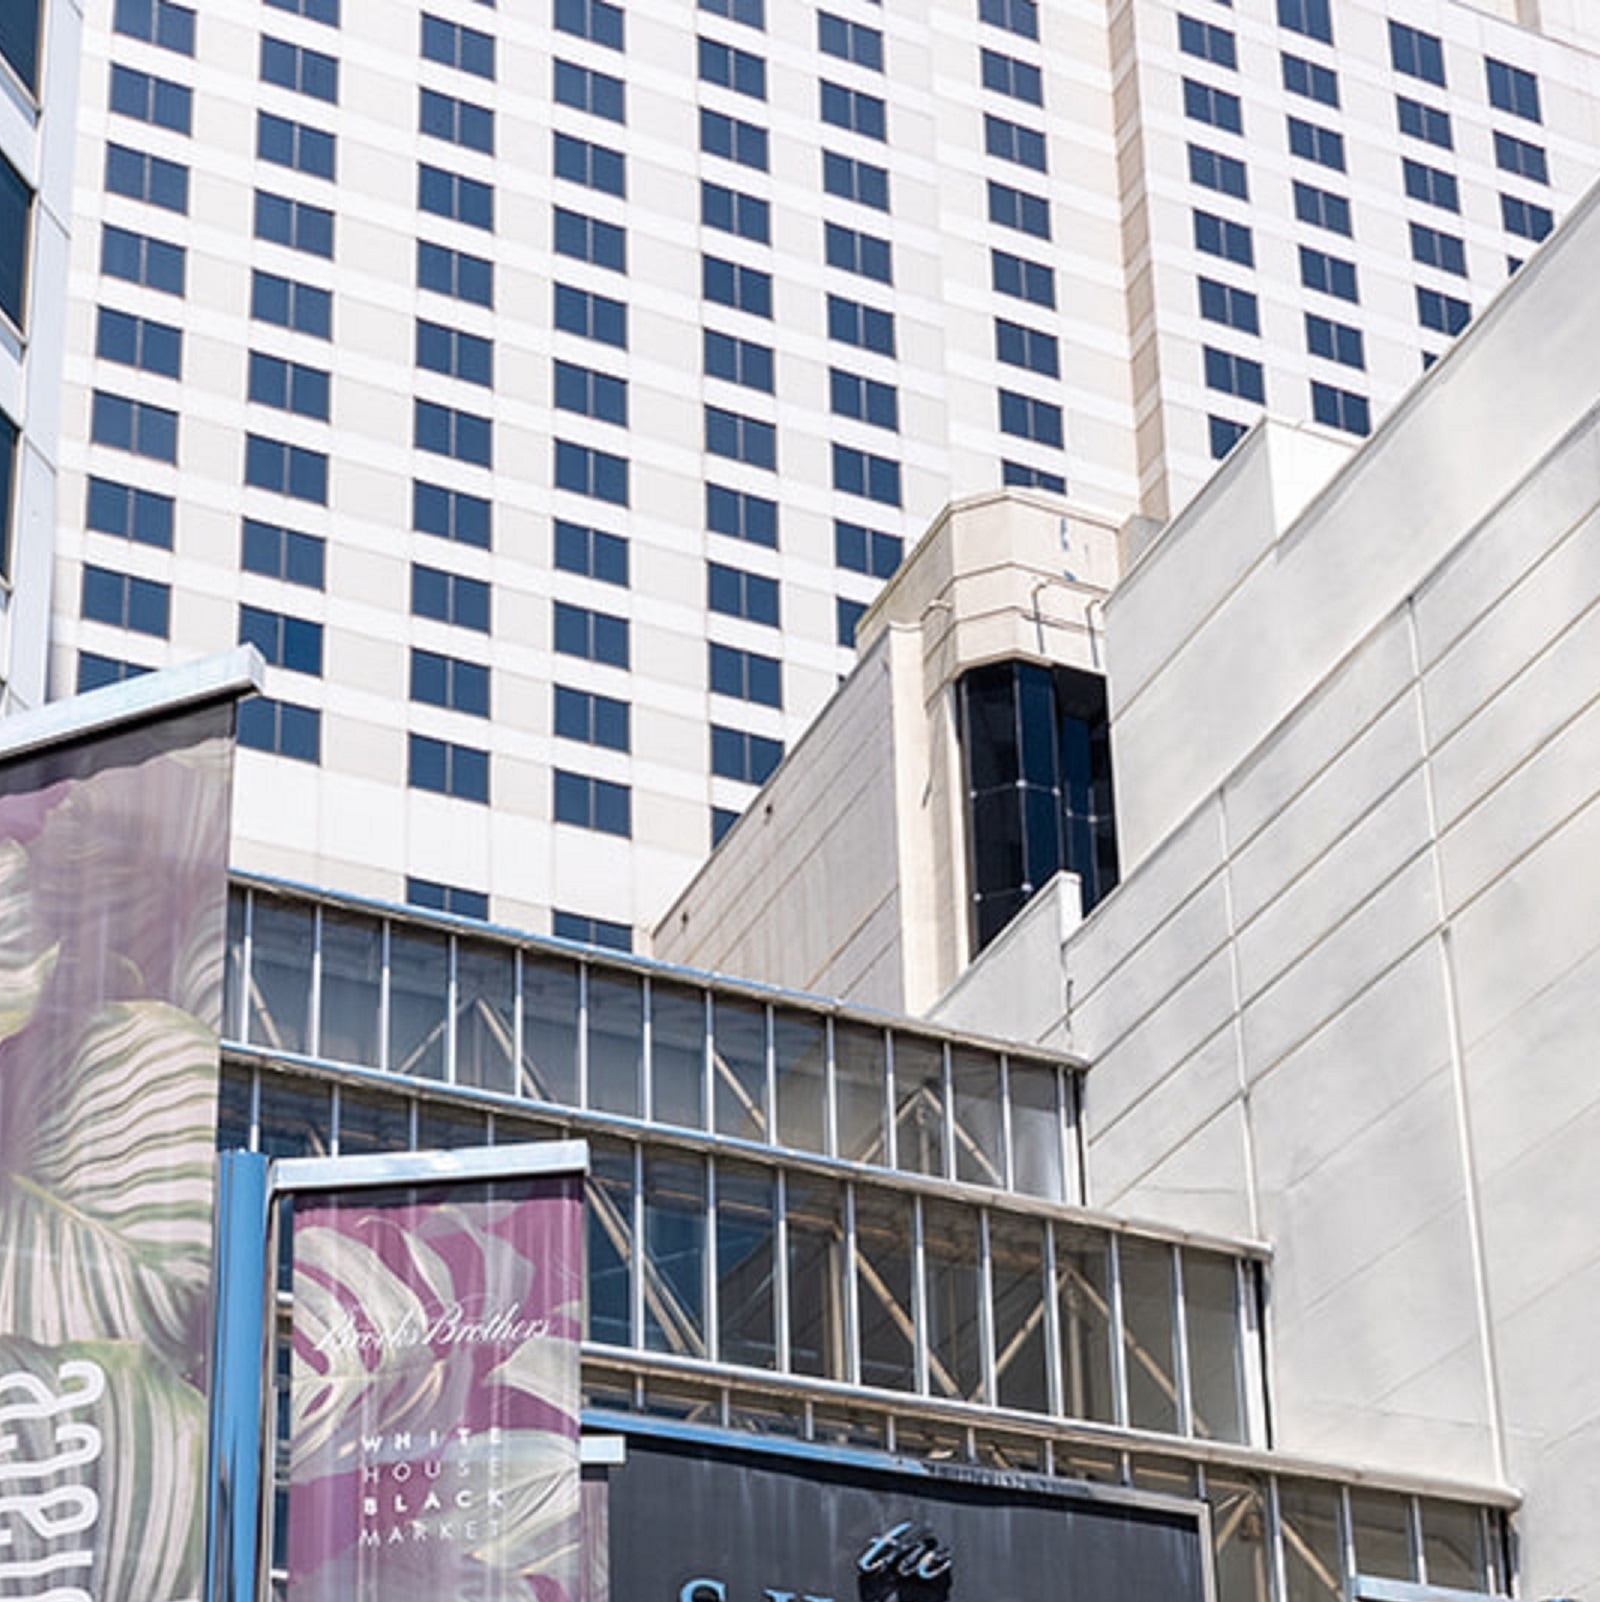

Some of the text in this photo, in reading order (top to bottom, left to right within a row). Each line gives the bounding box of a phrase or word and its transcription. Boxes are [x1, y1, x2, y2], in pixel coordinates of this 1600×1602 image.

[360, 1426, 505, 1454] WHITE
[364, 1458, 504, 1484] HOUSE
[362, 1489, 504, 1517] BLACK
[360, 1517, 504, 1547] MARKET
